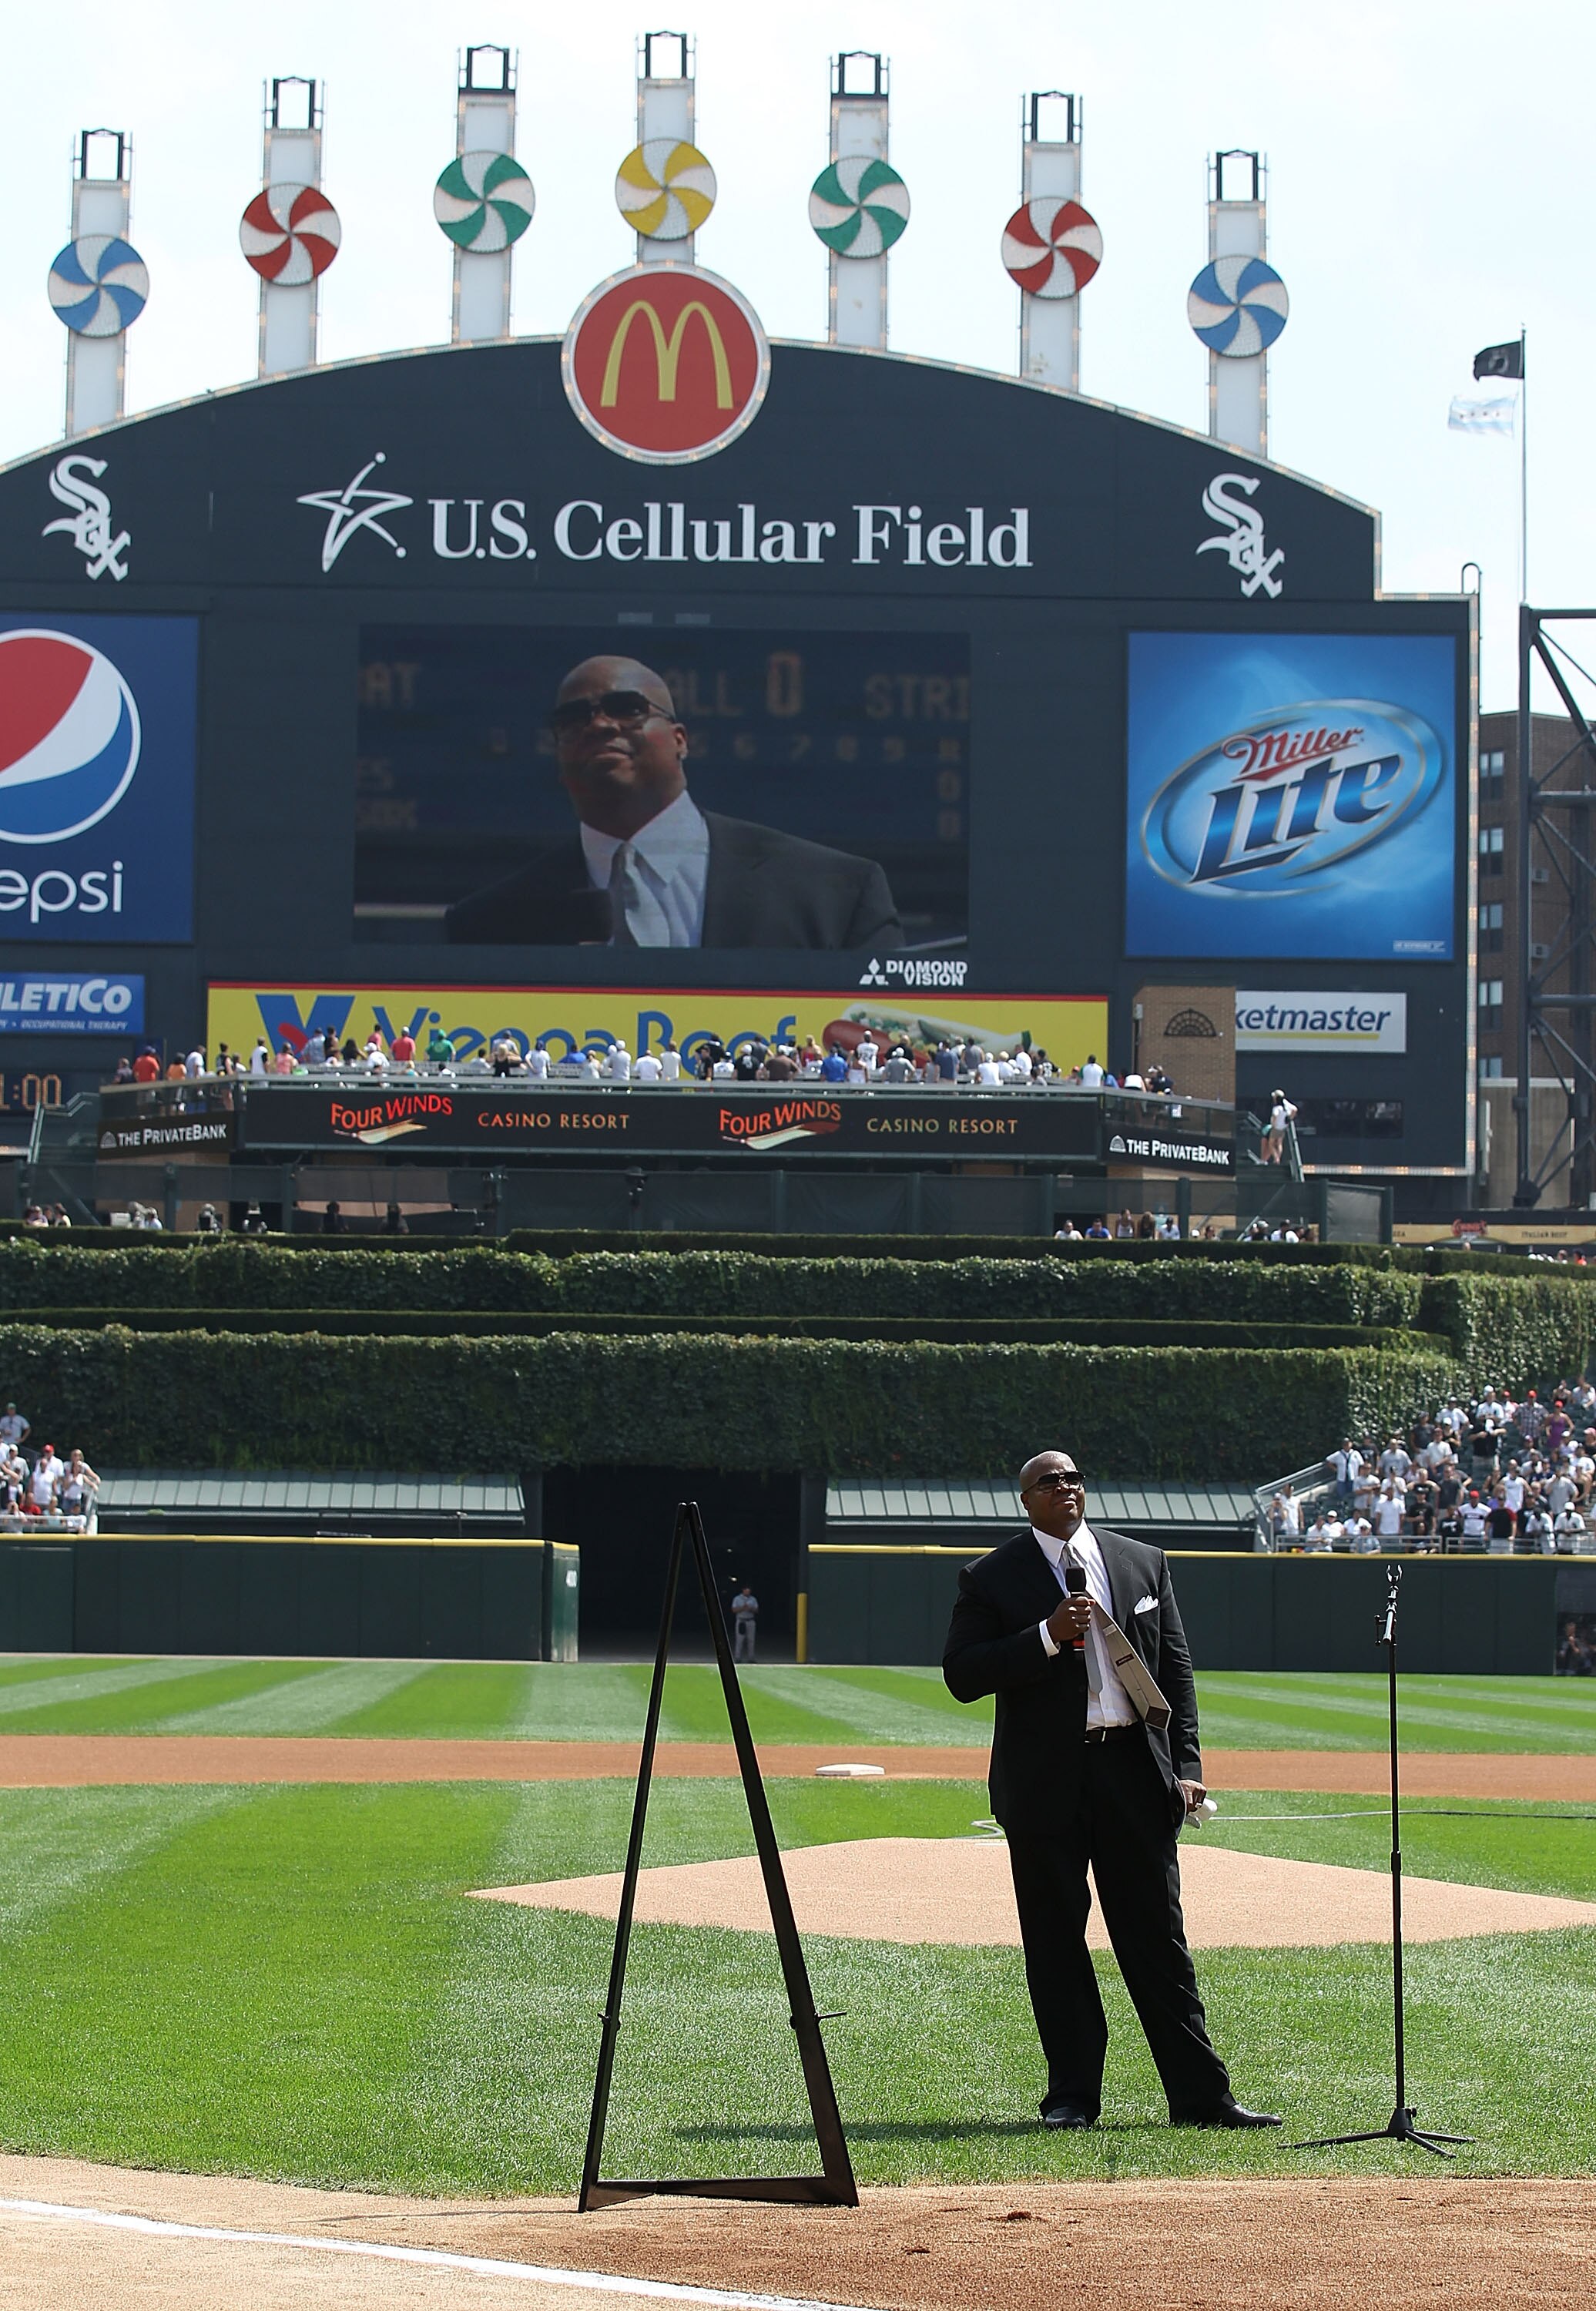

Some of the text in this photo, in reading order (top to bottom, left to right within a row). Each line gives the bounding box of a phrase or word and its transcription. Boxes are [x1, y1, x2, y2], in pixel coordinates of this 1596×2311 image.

[428, 499, 1033, 568] U.S. Cellular Field
[1222, 726, 1364, 775] Miller
[1190, 753, 1403, 884] Lite
[887, 960, 967, 974] DIAMOND
[904, 971, 964, 986] VISION
[330, 1094, 453, 1129] FOUR WINDS
[719, 1100, 842, 1135] FOUR WINDS
[478, 1112, 630, 1129] CASINO RESORT
[866, 1118, 1018, 1135] CASINO RESORT
[117, 1132, 140, 1147] THE
[1126, 1139, 1149, 1156] THE
